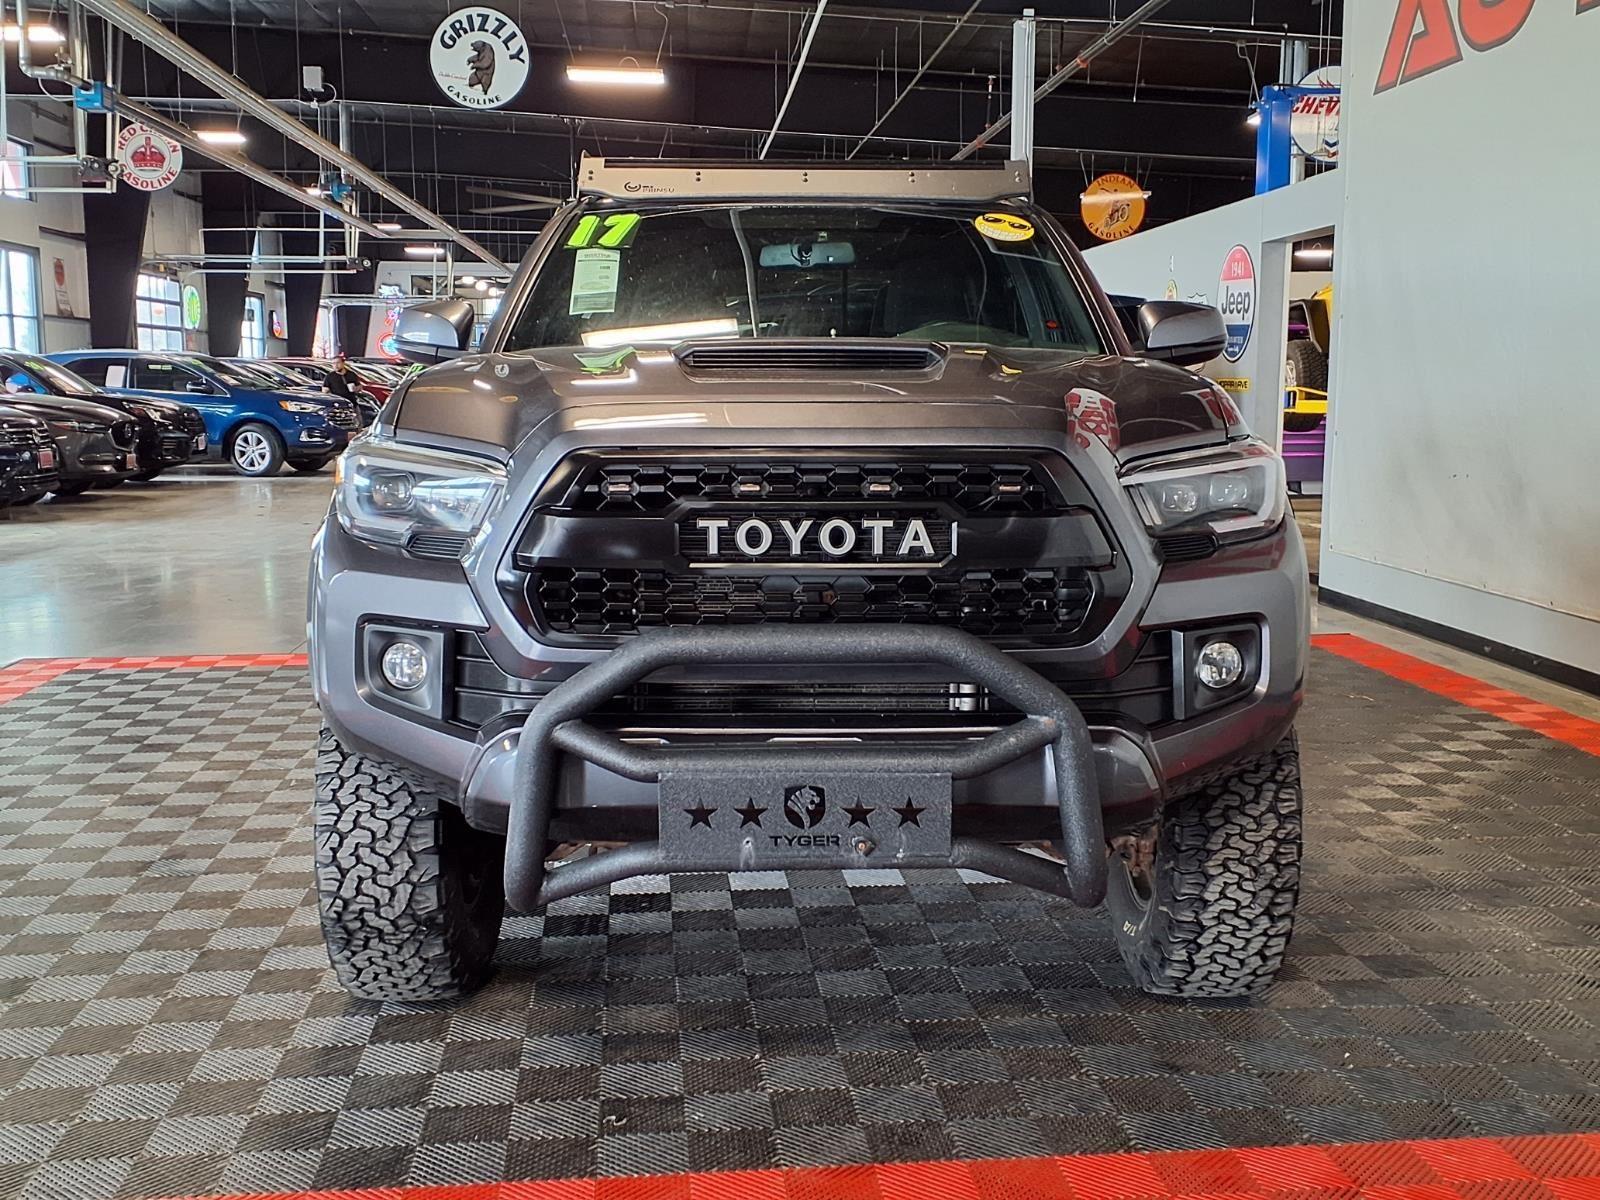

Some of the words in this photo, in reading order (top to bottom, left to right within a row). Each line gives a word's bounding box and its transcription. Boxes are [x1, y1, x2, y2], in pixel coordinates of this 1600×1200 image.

[440, 13, 525, 64] GRIZZLY
[447, 85, 502, 105] GASOLINE
[1096, 175, 1134, 188] INDIAN
[567, 213, 640, 248] 17
[1088, 222, 1134, 238] GASOLINE
[1231, 262, 1244, 277] 1941
[1222, 285, 1251, 320] Jeep
[697, 518, 935, 557] TOYOTA
[769, 835, 841, 847] TYGER
